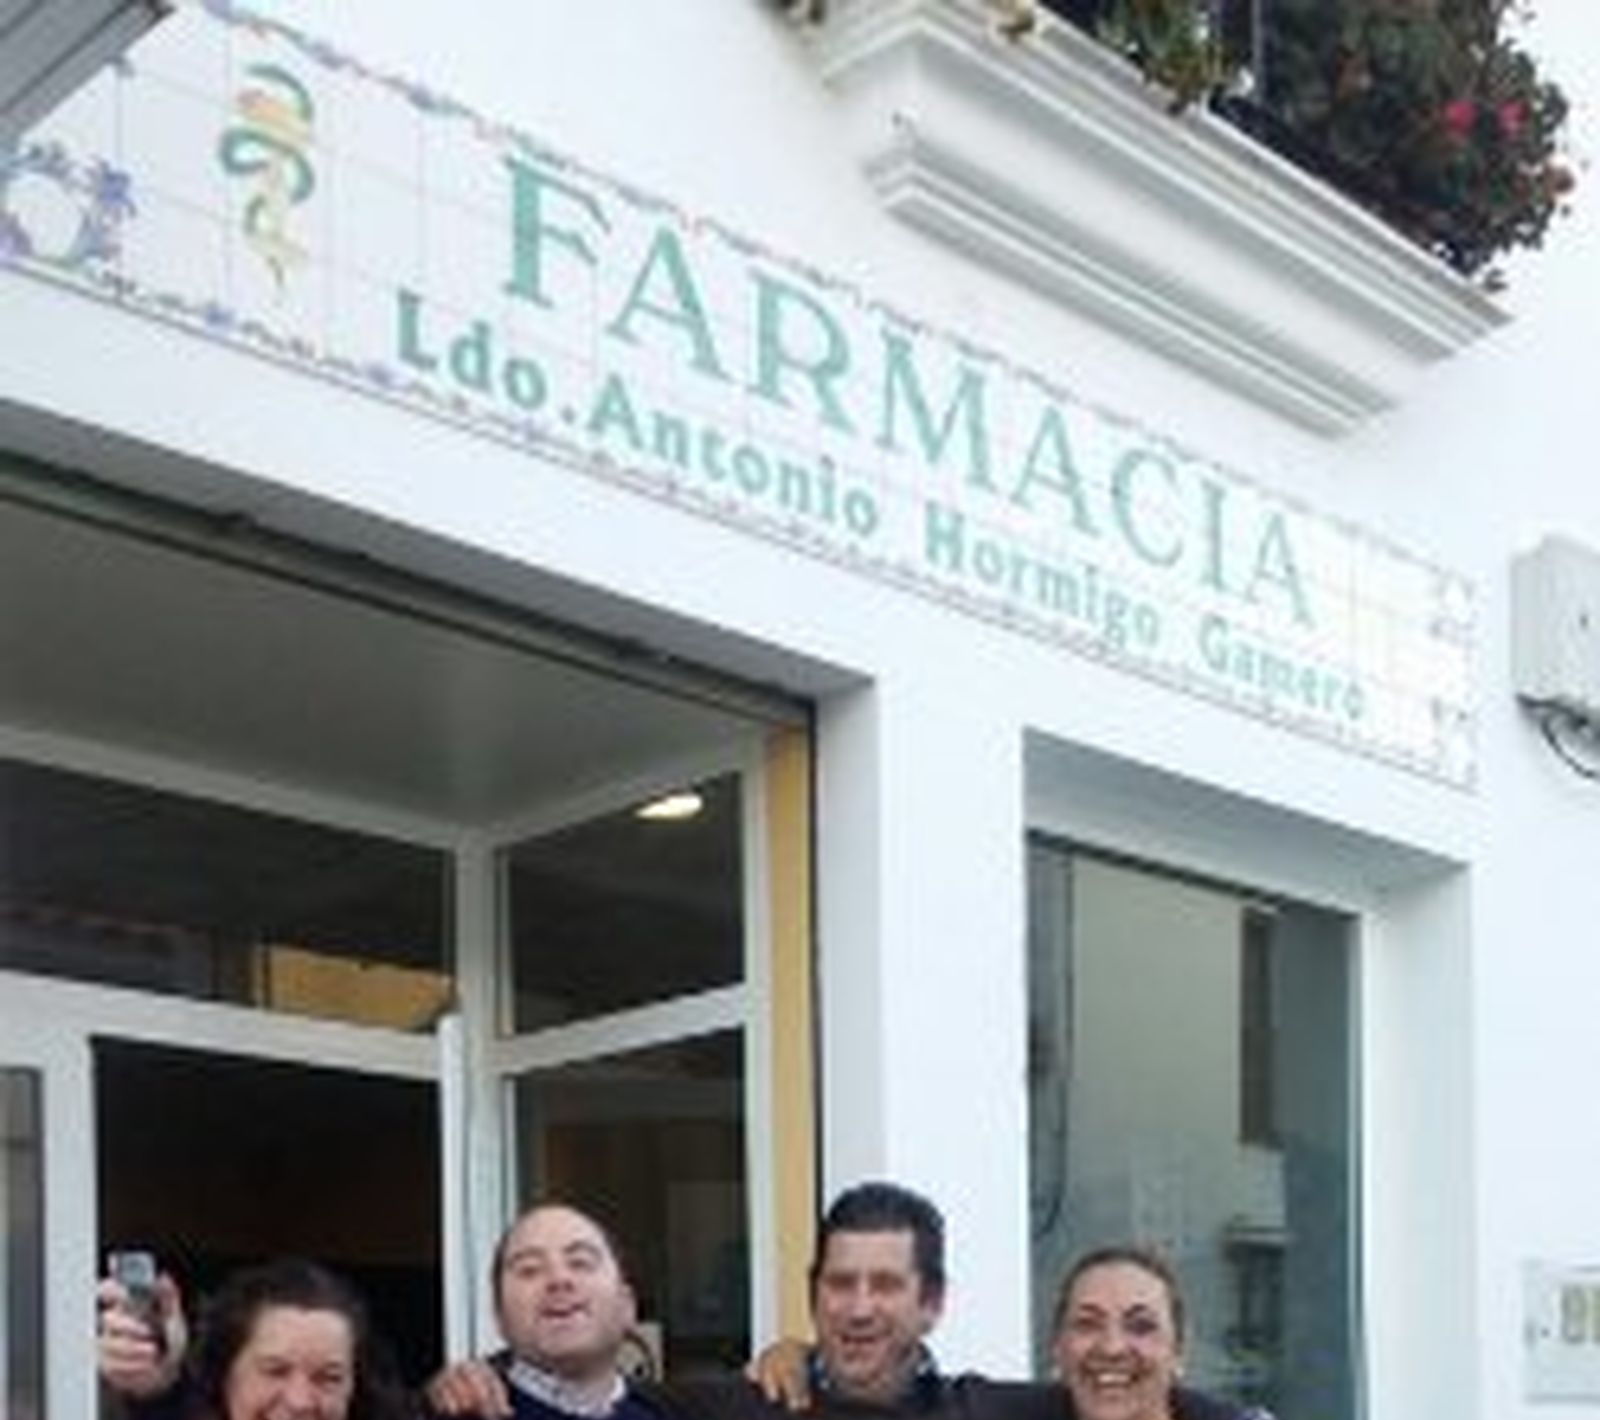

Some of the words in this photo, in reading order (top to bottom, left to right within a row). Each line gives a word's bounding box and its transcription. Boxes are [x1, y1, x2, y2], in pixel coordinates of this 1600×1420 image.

[504, 155, 1315, 631] FARMACIA
[924, 500, 1160, 649] Hormigo
[1198, 614, 1366, 722] Gamero
